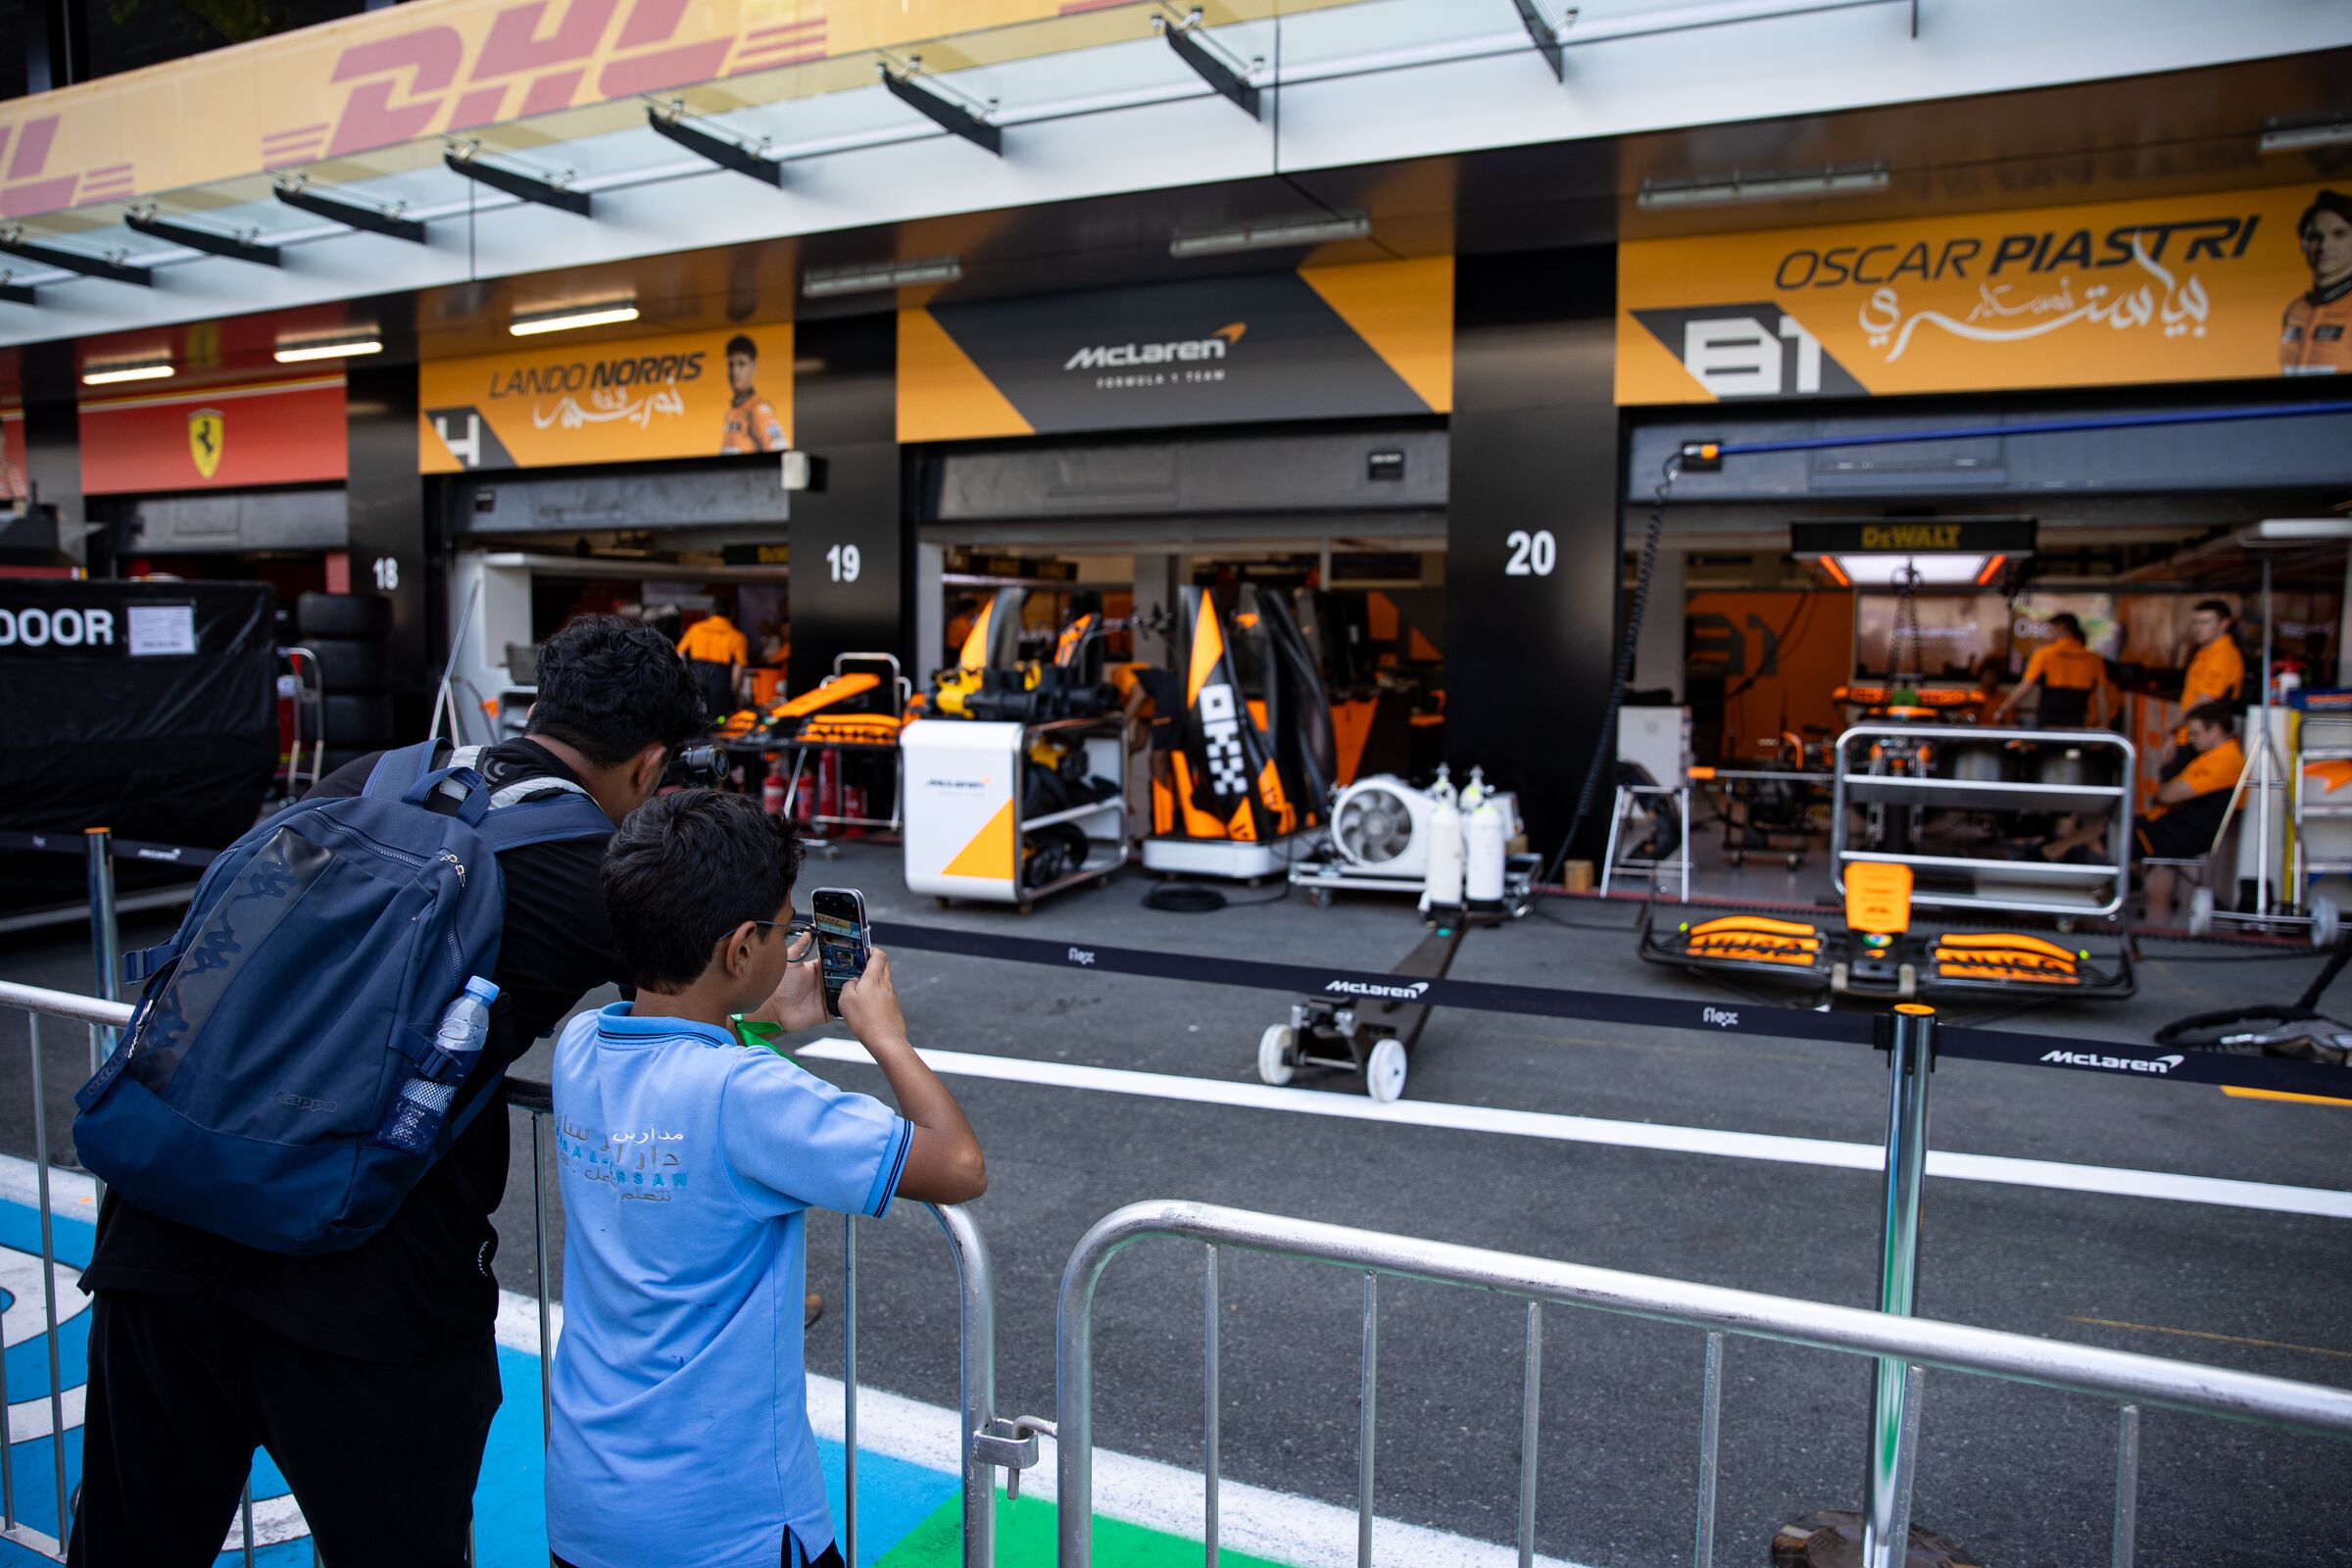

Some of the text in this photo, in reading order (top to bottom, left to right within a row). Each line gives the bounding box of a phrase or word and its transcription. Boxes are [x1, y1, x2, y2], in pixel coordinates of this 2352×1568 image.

[328, 0, 734, 157] DHL
[1773, 215, 2261, 291] OSCAR PIASTRI
[1063, 338, 1227, 370] McLaren
[1684, 315, 1822, 396] 81
[488, 351, 707, 398] LANDO NORRIS
[1096, 371, 1165, 390] FORMULA
[1185, 368, 1226, 384] TEAM
[826, 544, 861, 583] 19
[1505, 530, 1556, 576] 20
[372, 557, 399, 590] 18
[1325, 980, 1418, 999] McLaren
[2039, 1050, 2169, 1074] McLaren
[612, 1127, 684, 1144] مدارس
